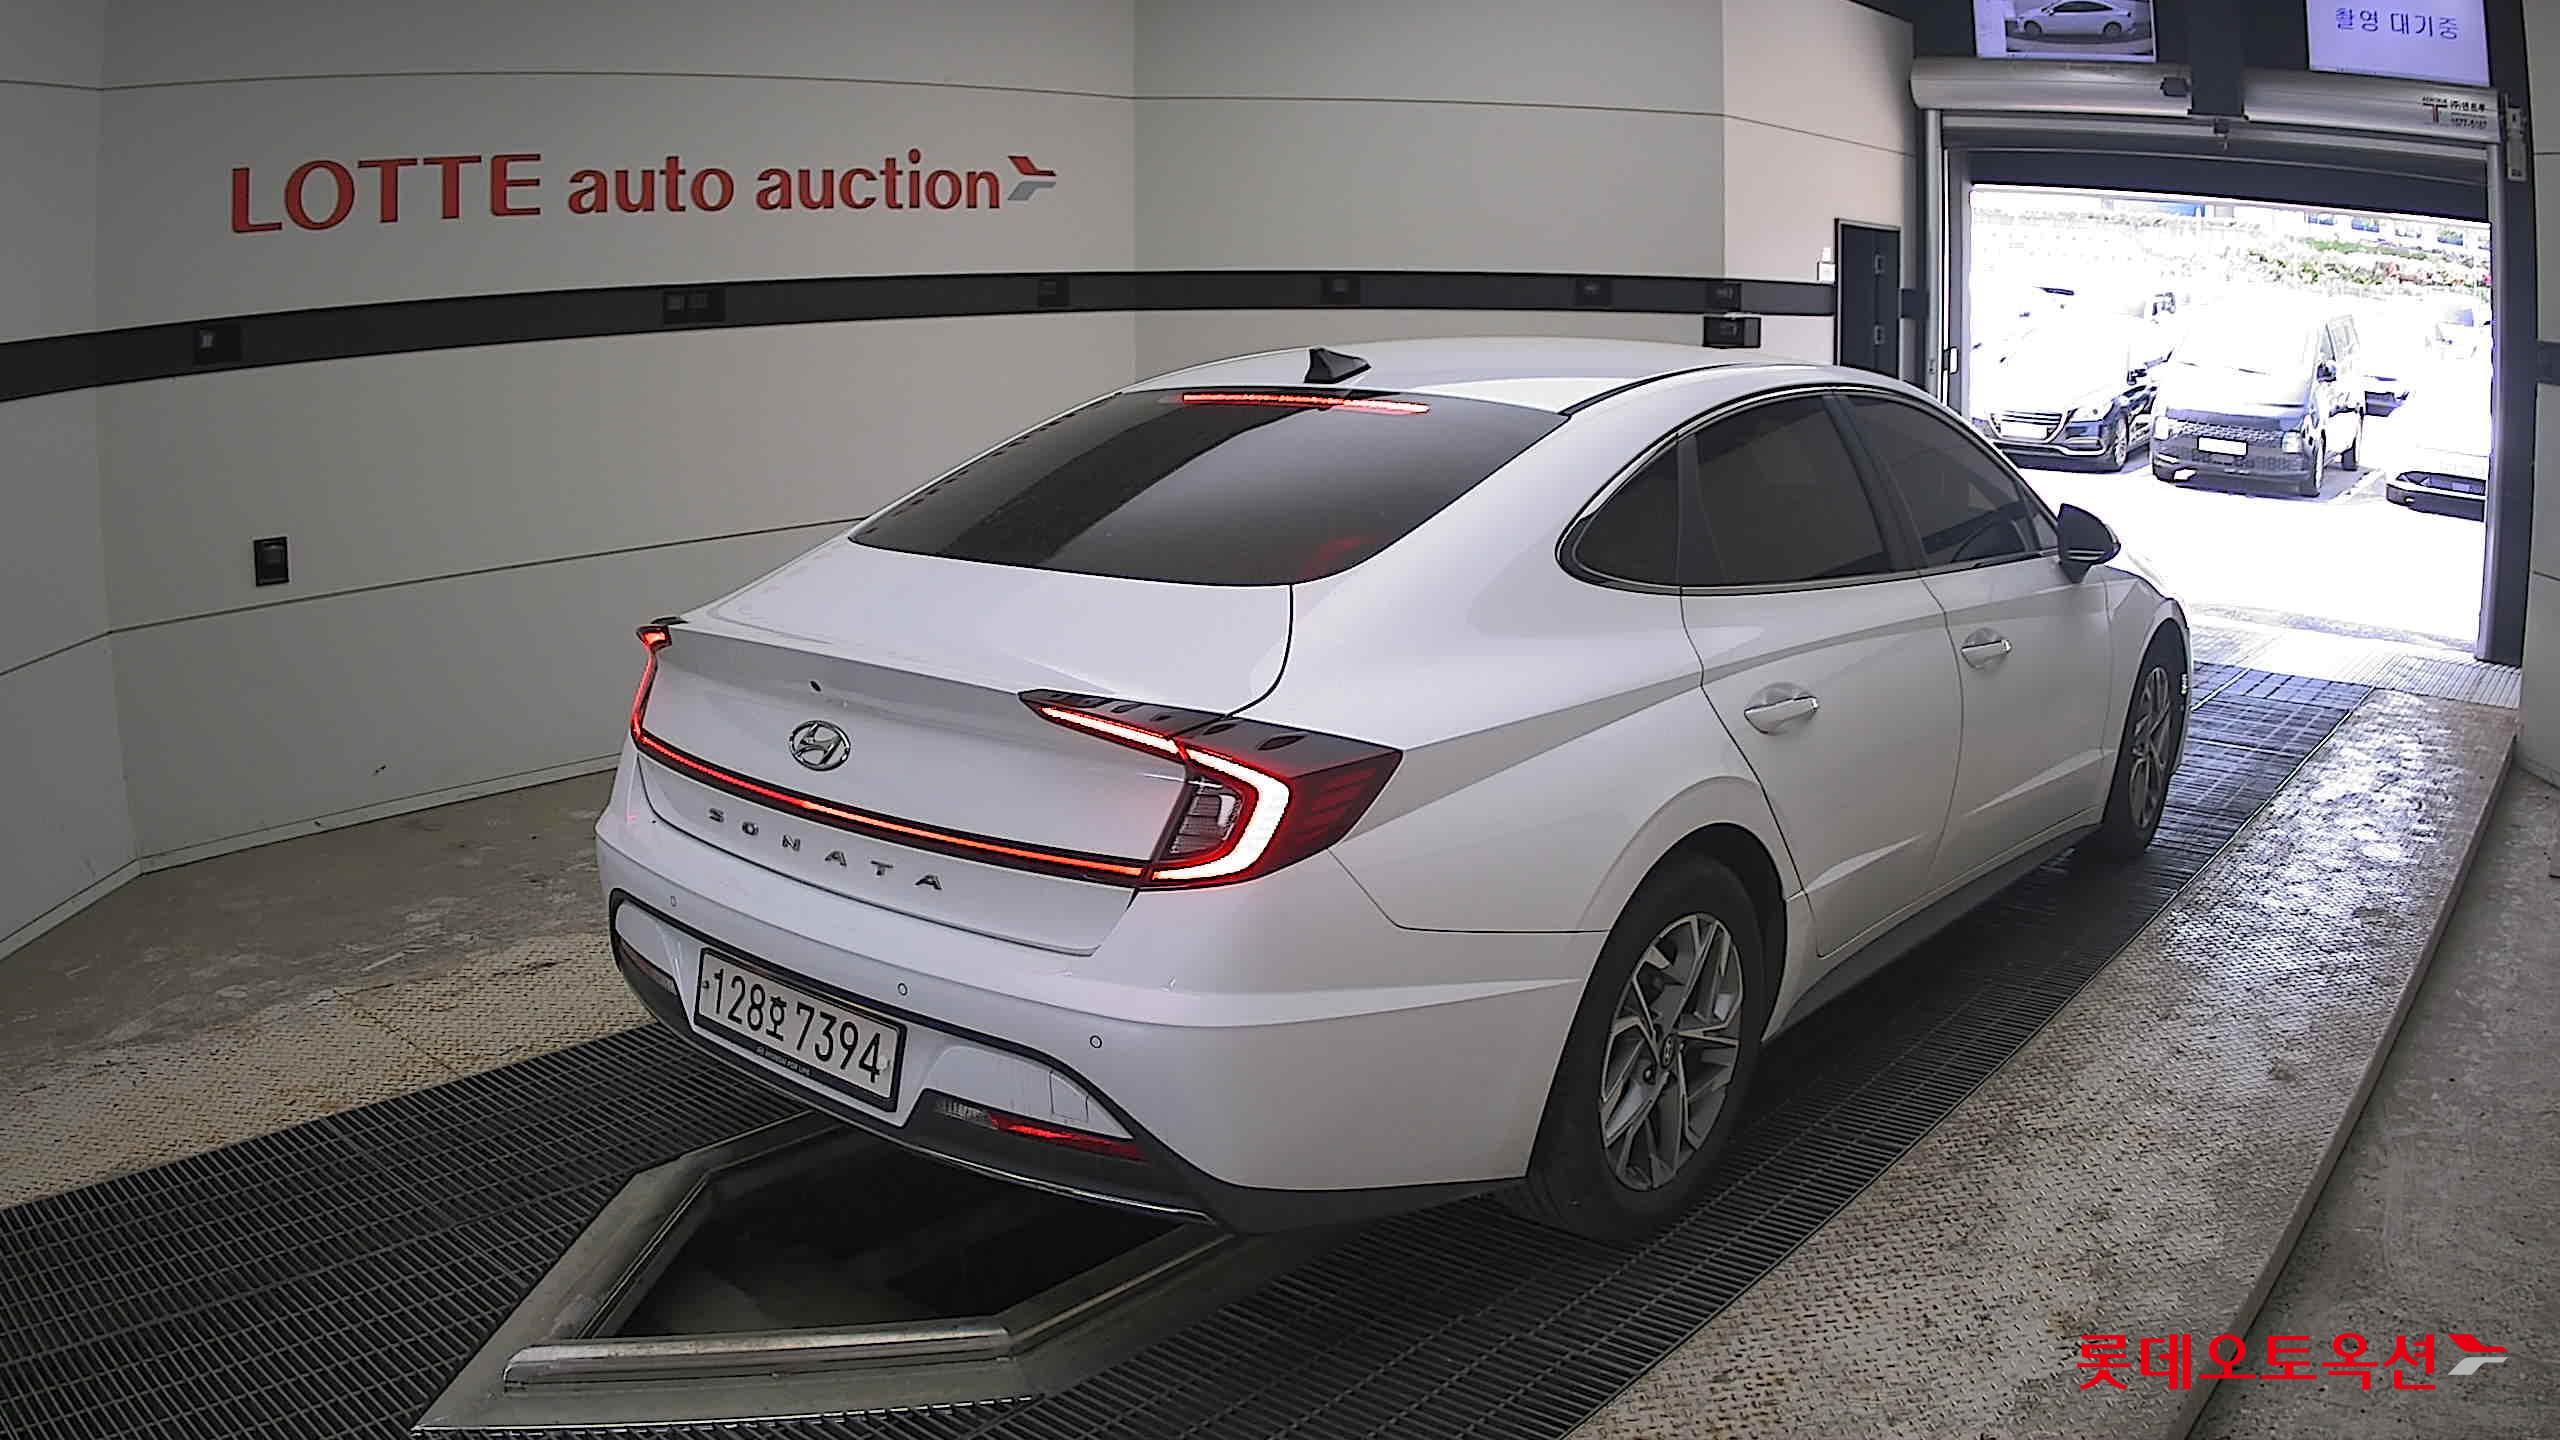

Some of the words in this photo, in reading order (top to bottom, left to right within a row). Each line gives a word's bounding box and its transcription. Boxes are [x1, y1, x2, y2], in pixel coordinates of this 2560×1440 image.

[2390, 13, 2458, 40] 대기중
[231, 153, 541, 234] LOTTE
[567, 154, 734, 216] auto
[755, 148, 1001, 211] auction
[707, 806, 945, 891] SONATA
